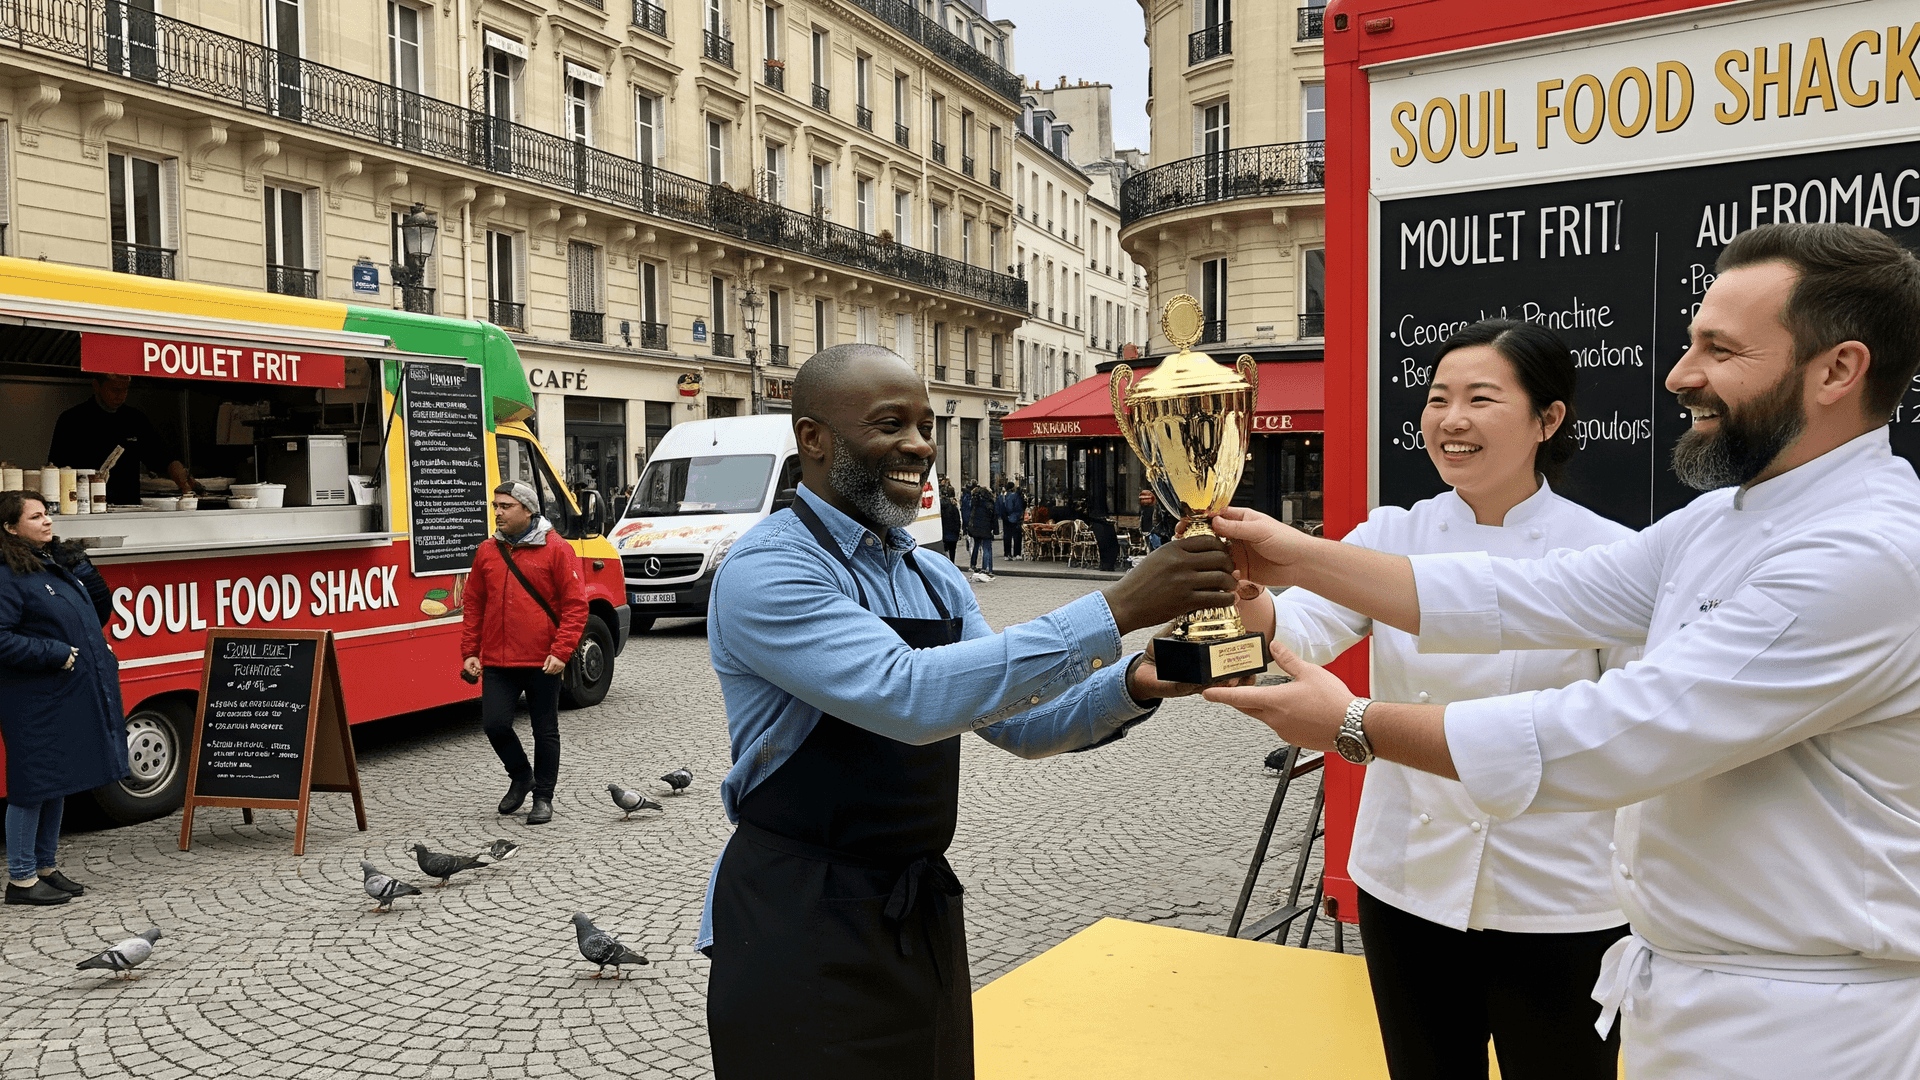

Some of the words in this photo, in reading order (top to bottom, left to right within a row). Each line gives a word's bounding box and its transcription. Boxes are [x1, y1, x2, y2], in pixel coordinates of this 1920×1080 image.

[1390, 88, 1518, 168] SOUL
[1537, 61, 1695, 149] FOOD
[1714, 21, 1920, 125] SHACK
[1400, 210, 1526, 271] MOULET
[1696, 202, 1738, 247] AU
[143, 341, 243, 378] POULET
[252, 351, 301, 382] FRIT
[528, 368, 588, 391] CAFÉ
[111, 581, 207, 641] SOUL
[215, 573, 302, 627] FOOD
[309, 564, 400, 617] SHACK
